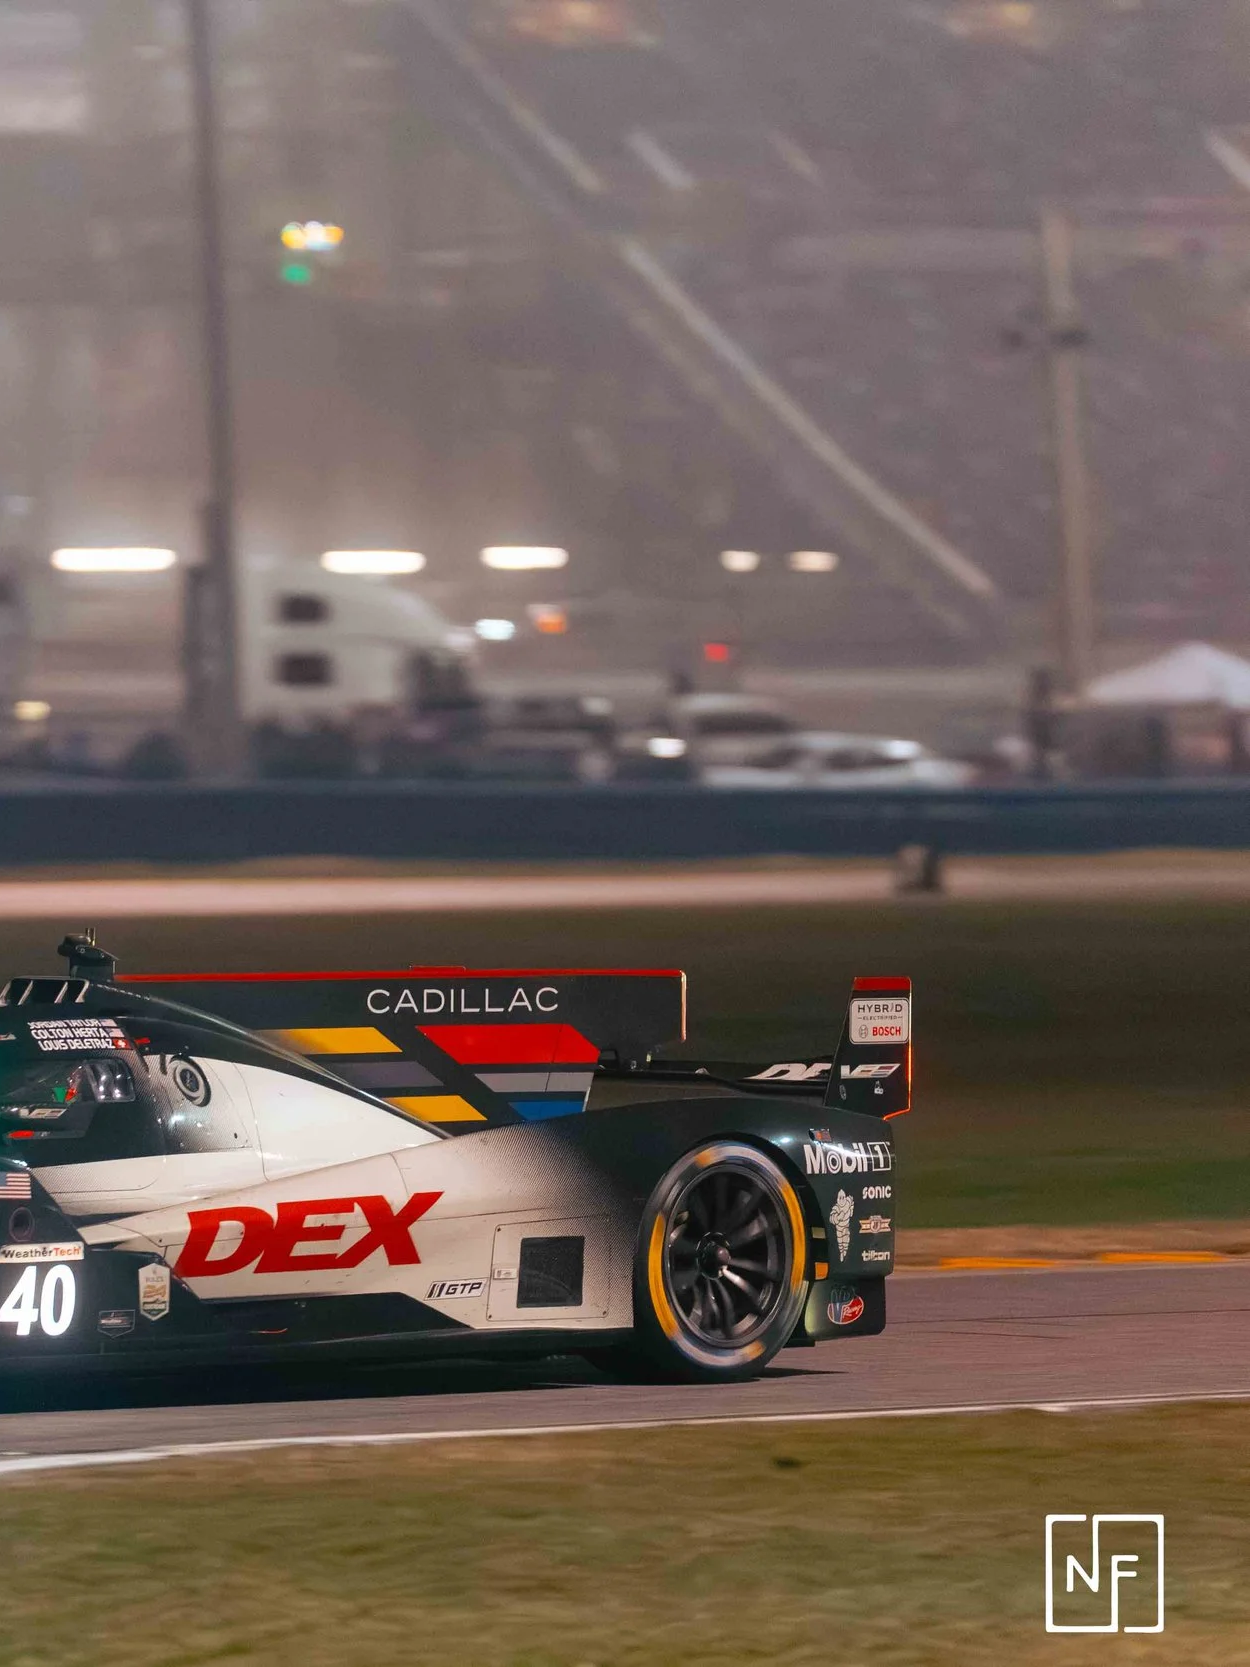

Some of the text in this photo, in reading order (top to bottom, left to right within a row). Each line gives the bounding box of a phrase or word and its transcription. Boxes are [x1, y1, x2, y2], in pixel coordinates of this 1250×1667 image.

[367, 988, 559, 1014] CADILLAC
[857, 1004, 903, 1013] HYBRID
[28, 1019, 102, 1029] JORDAN TAYLOR
[31, 1028, 109, 1040] COLTON HERTA
[872, 1026, 902, 1037] BOSCH
[38, 1039, 116, 1051] LOUIS DELETRAZ
[803, 1142, 869, 1175] Mobil
[174, 1191, 445, 1278] DEX
[1, 1246, 82, 1259] WeatherTech
[445, 1281, 483, 1296] GTP
